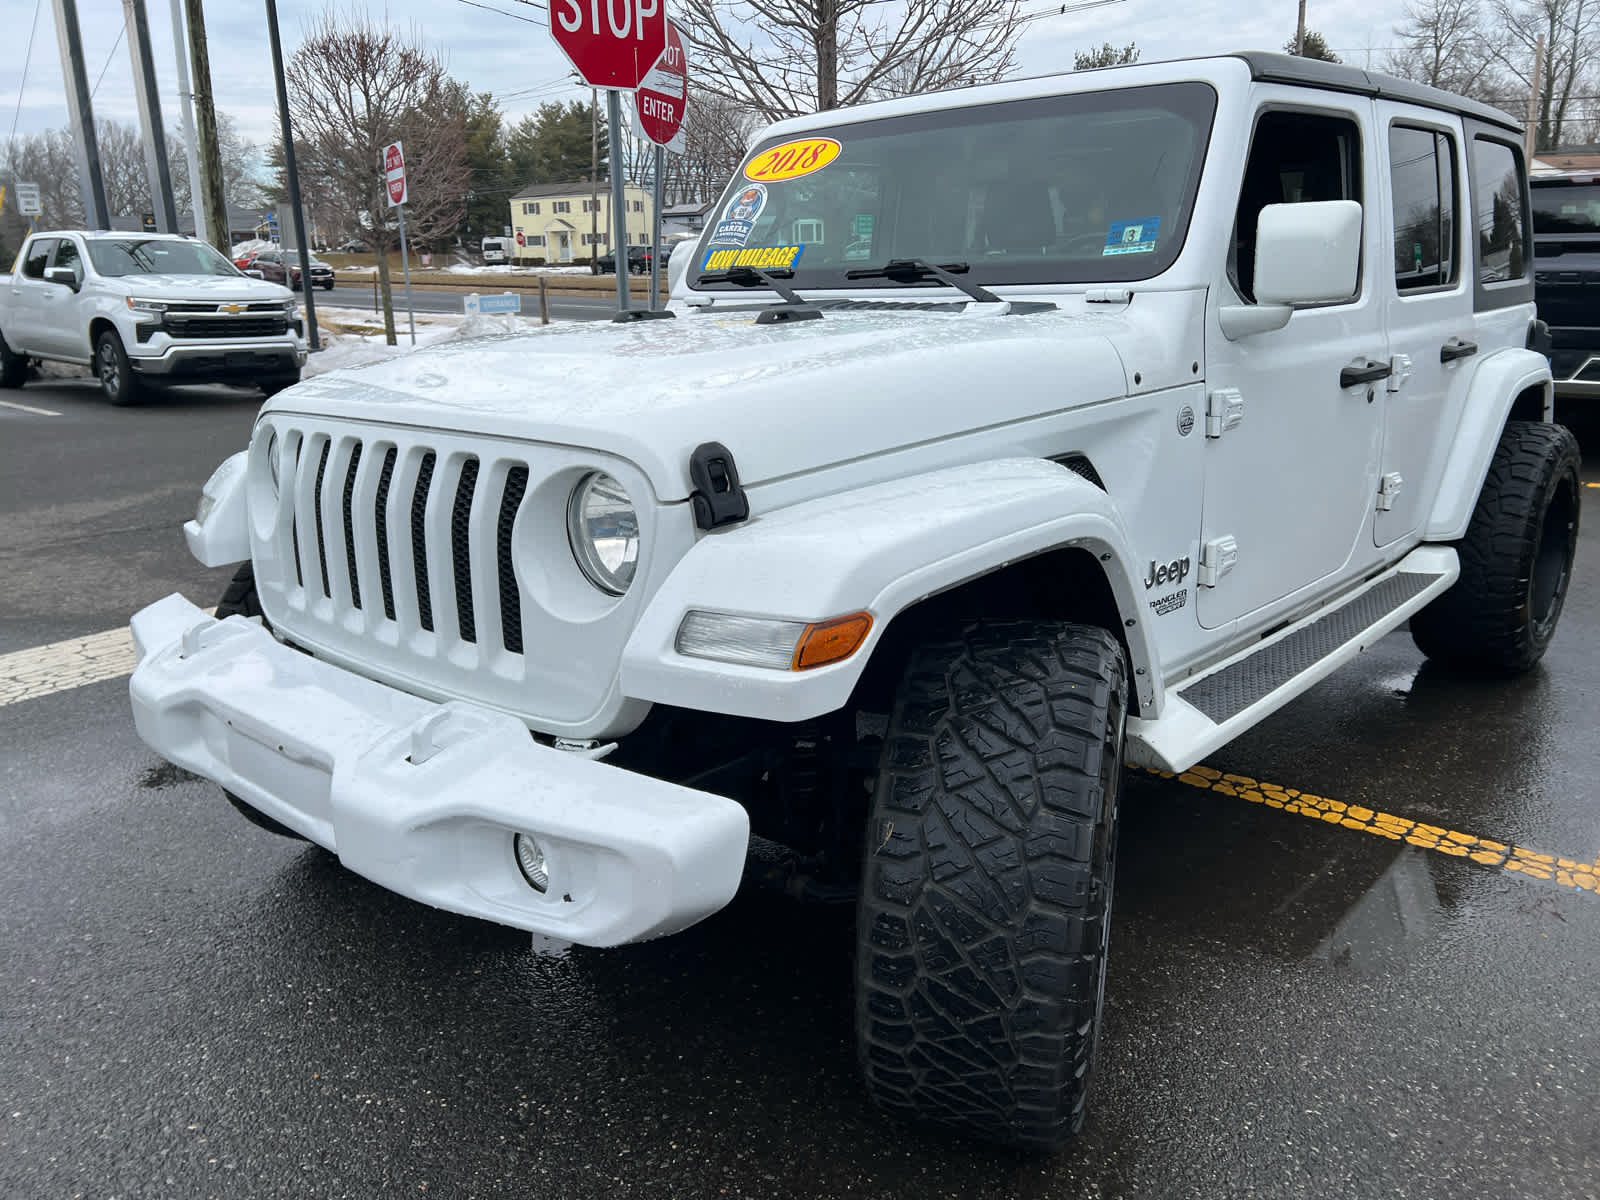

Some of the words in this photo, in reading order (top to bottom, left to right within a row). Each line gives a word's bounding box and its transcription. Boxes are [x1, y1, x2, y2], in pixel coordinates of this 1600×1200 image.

[557, 0, 658, 40] STOP
[643, 96, 674, 124] ENTER
[754, 143, 828, 177] 2018
[1127, 228, 1136, 242] 3
[705, 249, 740, 271] LOW
[734, 246, 800, 268] MILEAGE
[1144, 556, 1190, 590] Jeep
